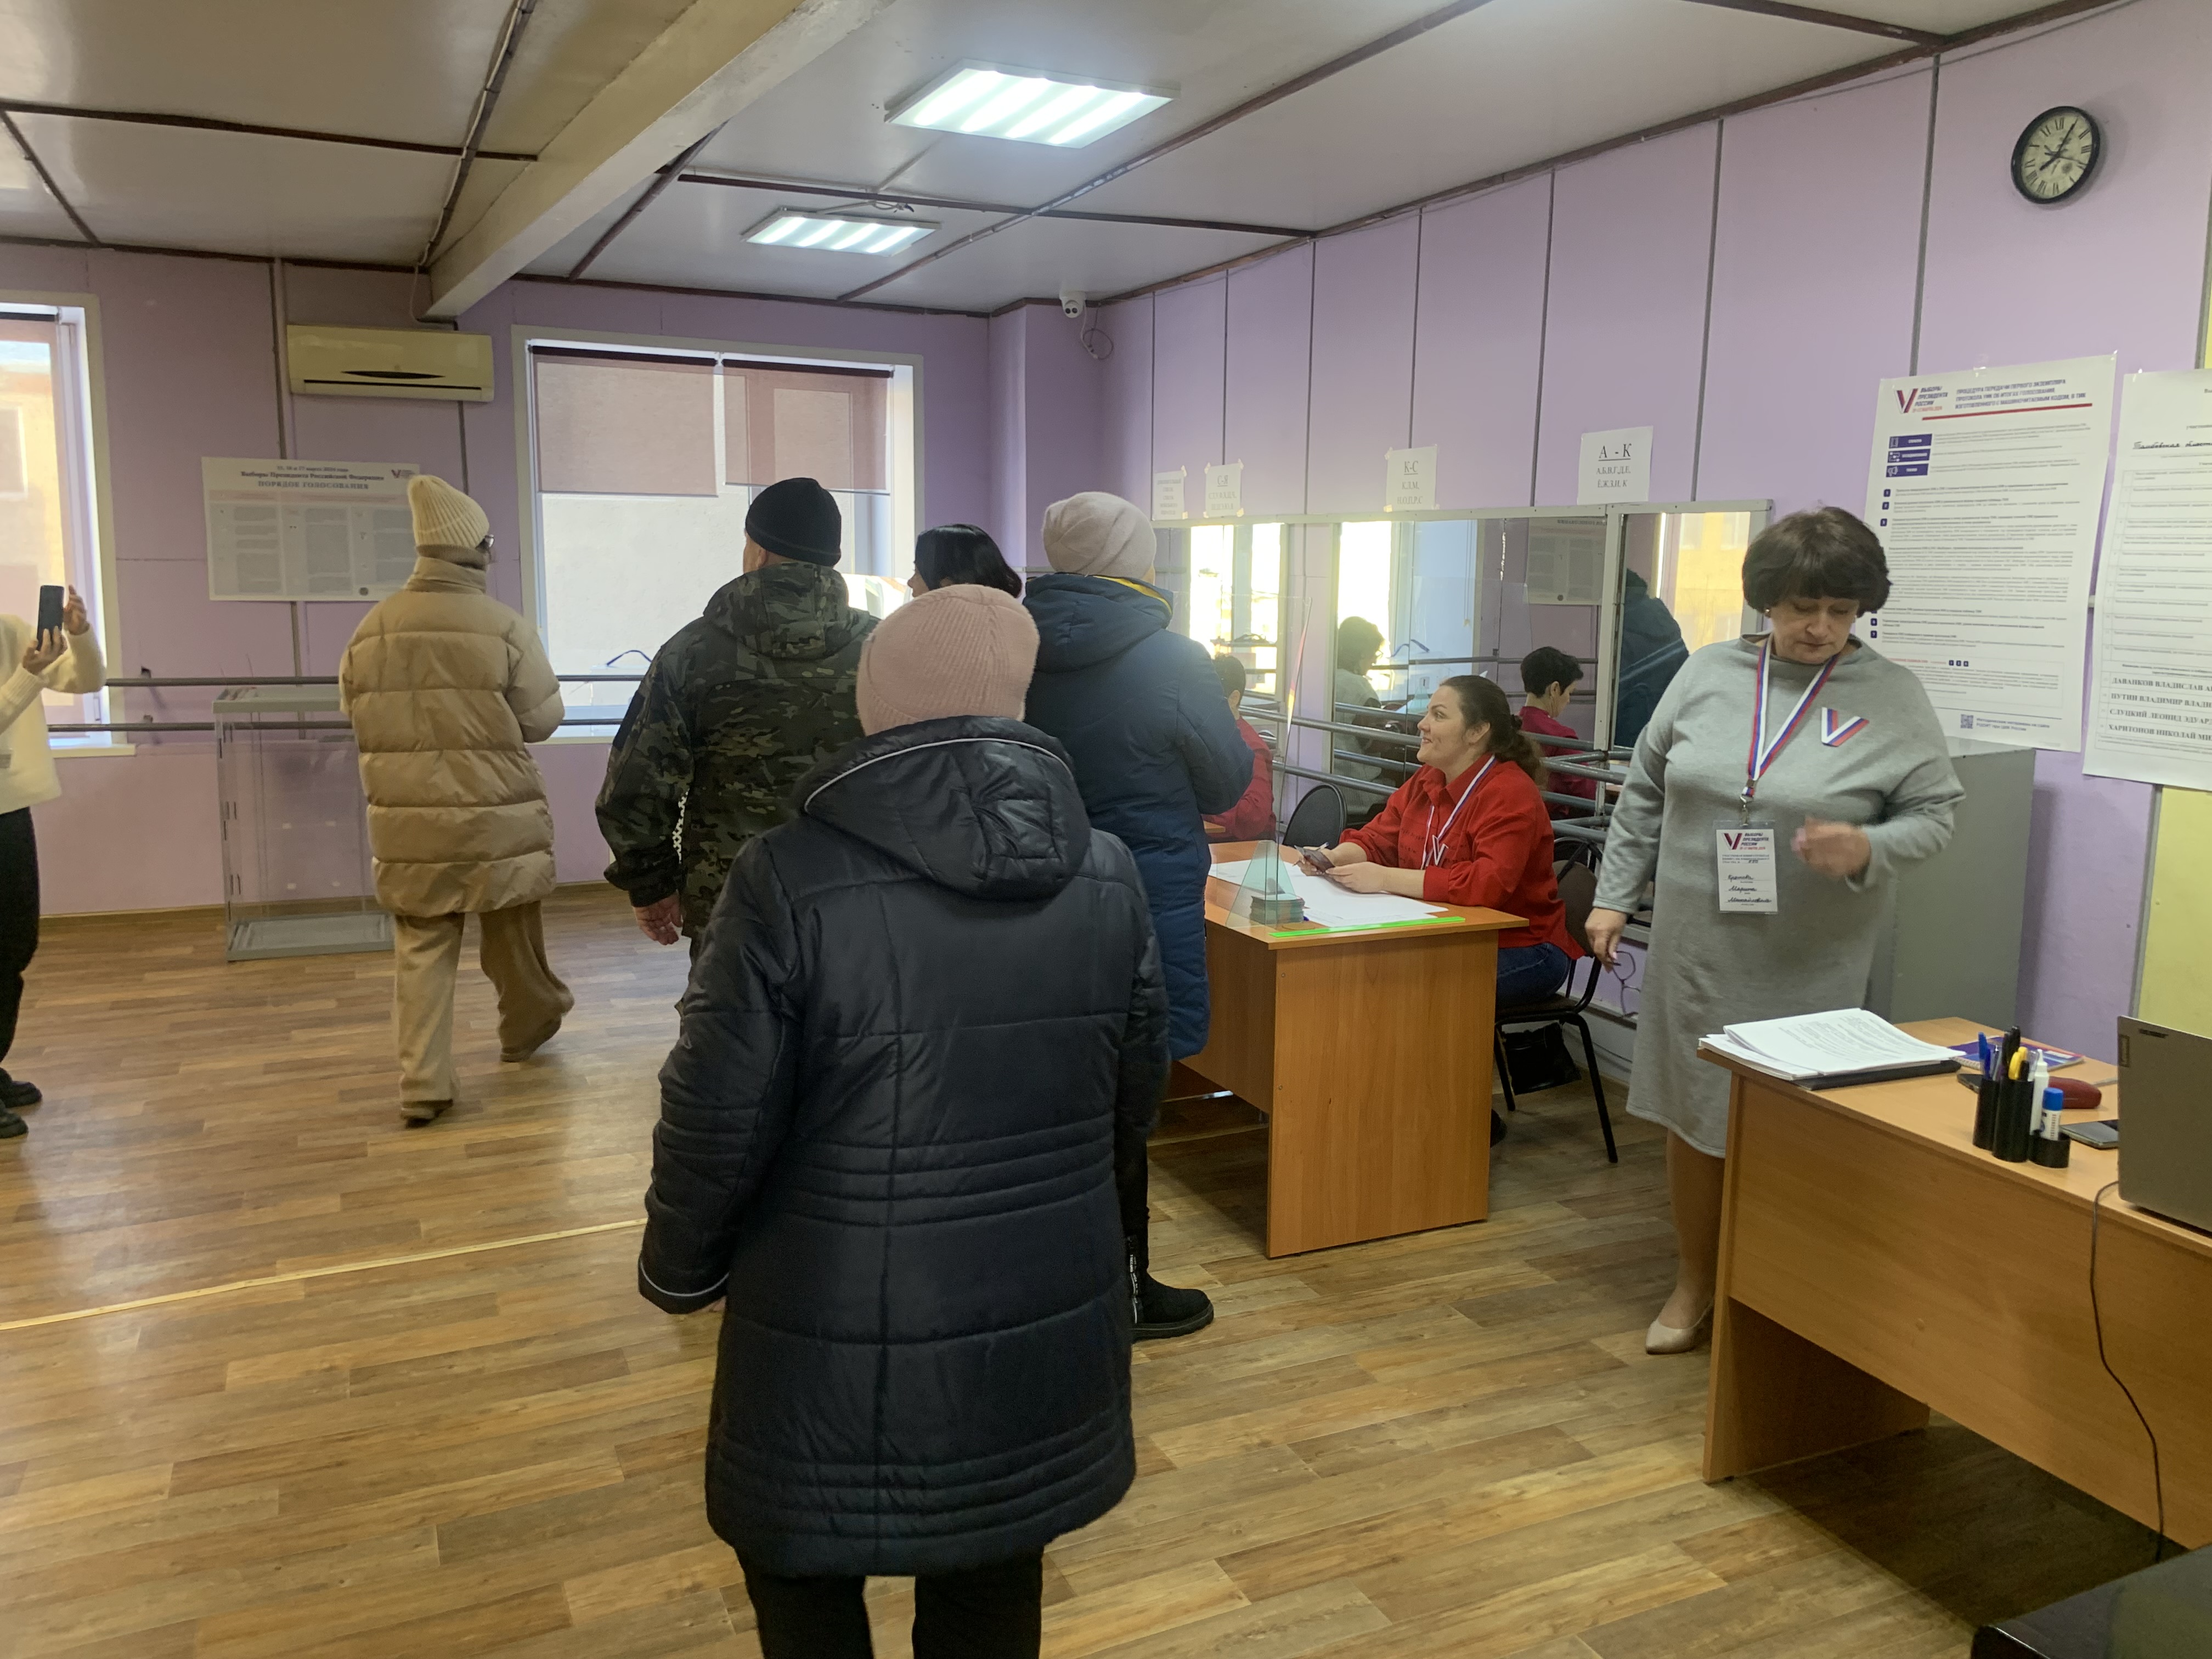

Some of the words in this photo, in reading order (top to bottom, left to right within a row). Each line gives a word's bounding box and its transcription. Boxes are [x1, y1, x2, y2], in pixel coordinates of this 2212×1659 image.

[1599, 445, 1607, 459] А
[1623, 443, 1632, 458] К
[1404, 460, 1419, 473] К-С
[1217, 475, 1228, 485] С-Я
[2112, 677, 2153, 686] ДАВАНКОВ
[2155, 681, 2203, 691] ВЛАДИСЛАВ
[2111, 692, 2137, 701] ПУТИН
[2140, 695, 2183, 705] ВЛАДИМИР
[2109, 708, 2147, 718] СЛУЦКИЙ
[2149, 712, 2182, 723] ЛЕОНИД
[2108, 724, 2155, 735] ХАРИТОНОВ
[2156, 729, 2196, 740] НИКОЛАЙ
